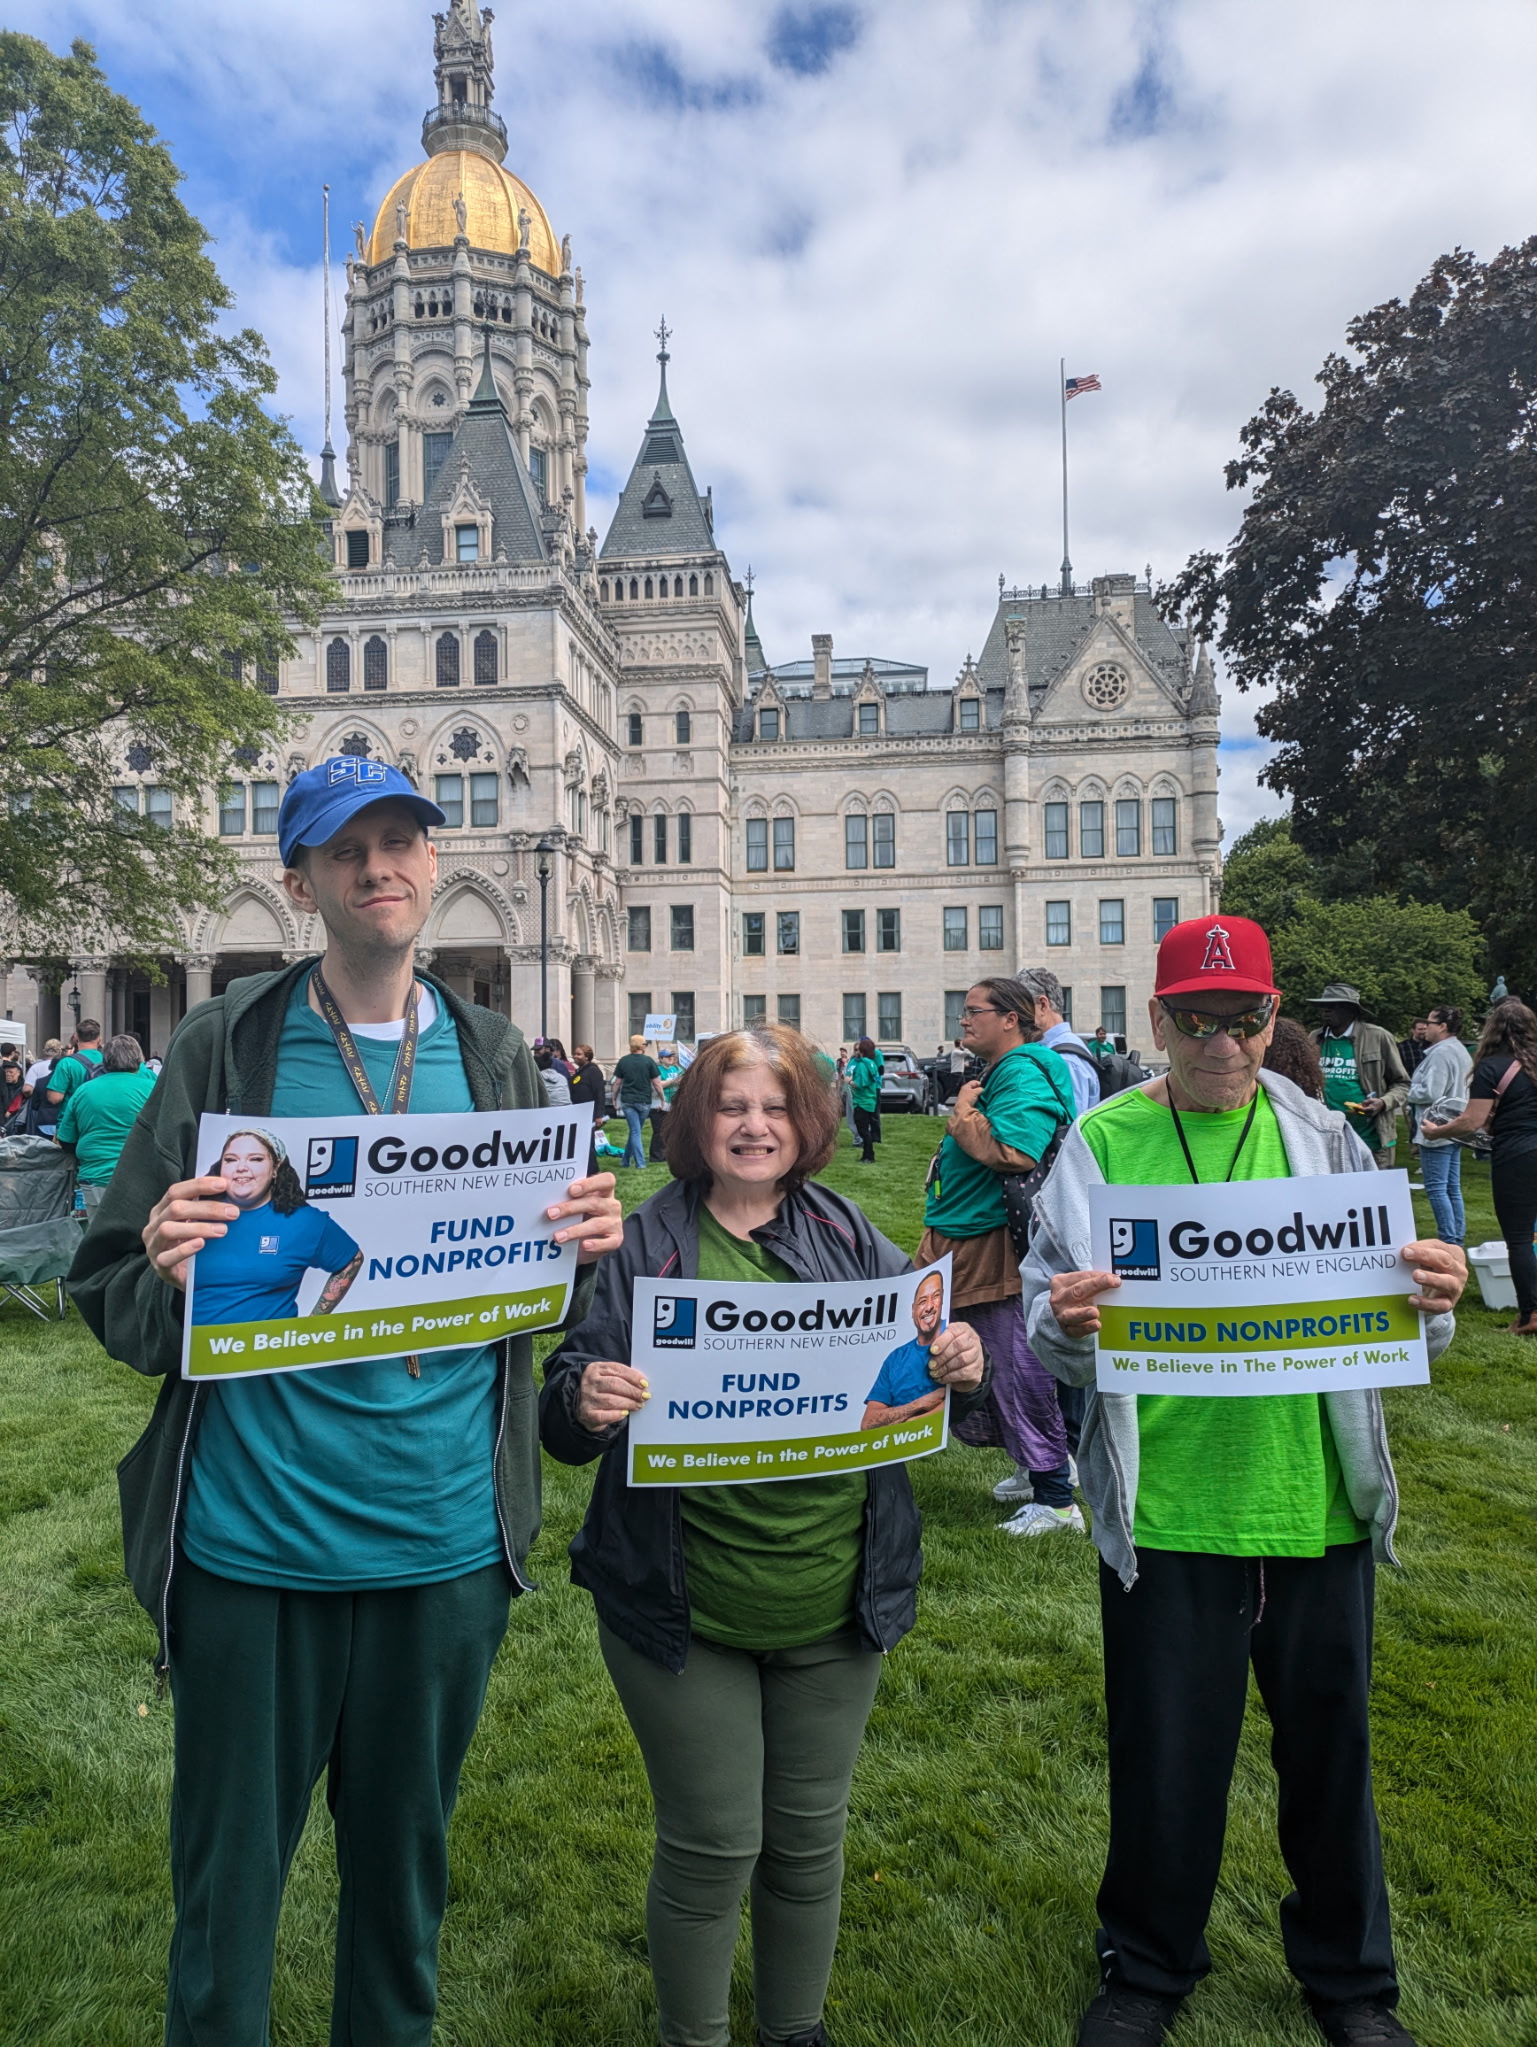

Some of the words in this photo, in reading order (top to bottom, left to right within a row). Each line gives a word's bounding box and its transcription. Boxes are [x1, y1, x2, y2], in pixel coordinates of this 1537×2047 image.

[1200, 924, 1236, 969] A
[367, 1123, 577, 1174] Goodwill
[308, 1184, 353, 1196] goodwill
[364, 1178, 457, 1198] SOUTHERN
[462, 1175, 501, 1191] NEW
[504, 1166, 575, 1186] ENGLAND
[430, 1215, 514, 1244] FUND
[1168, 1205, 1391, 1260] Goodwill
[368, 1239, 562, 1280] NONPROFITS
[1114, 1267, 1158, 1277] goodwill
[1170, 1264, 1266, 1283] SOUTHERN
[1273, 1261, 1310, 1278] NEW
[1316, 1254, 1396, 1275] ENGLAND
[209, 1336, 246, 1355] We
[253, 1328, 336, 1351] Believe
[344, 1324, 363, 1341] in
[370, 1319, 404, 1337] the
[411, 1312, 473, 1333] Power
[479, 1305, 500, 1323] of
[504, 1298, 551, 1318] Work
[705, 1292, 898, 1332] Goodwill
[1129, 1321, 1207, 1343] FUND
[1217, 1311, 1390, 1343] NONPROFITS
[656, 1337, 694, 1347] goodwill
[703, 1337, 786, 1351] SOUTHERN
[790, 1336, 825, 1349] NEW
[829, 1329, 896, 1347] ENGLAND
[1112, 1357, 1140, 1372] We
[1147, 1358, 1214, 1374] Believe
[1220, 1357, 1238, 1373] in
[1245, 1358, 1277, 1372] The
[1283, 1355, 1337, 1371] Power
[1342, 1351, 1359, 1366] of
[1364, 1347, 1410, 1365] Work
[722, 1372, 800, 1393] FUND
[668, 1393, 848, 1420] NONPROFITS
[648, 1454, 677, 1469] We
[683, 1451, 751, 1468] Believe
[756, 1450, 773, 1464] in
[779, 1447, 808, 1461] the
[814, 1442, 868, 1459] Power
[872, 1435, 889, 1450] of
[892, 1424, 933, 1444] Work
